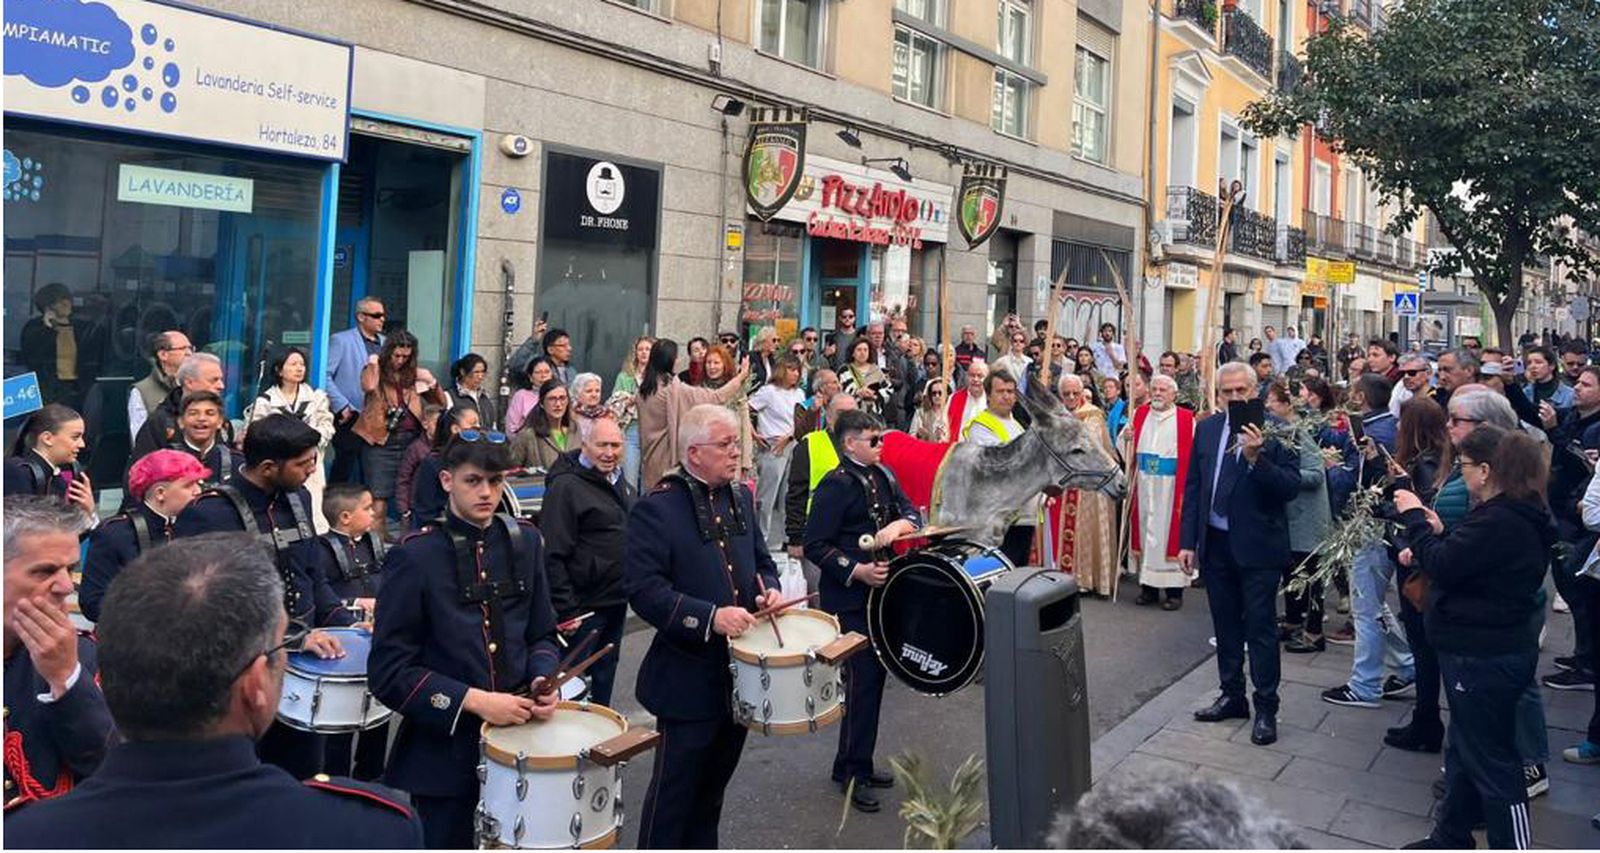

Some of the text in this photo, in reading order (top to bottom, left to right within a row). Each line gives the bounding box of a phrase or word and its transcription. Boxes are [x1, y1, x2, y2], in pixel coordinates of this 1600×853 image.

[267, 81, 337, 109] Self-service
[322, 133, 337, 151] 84
[128, 176, 245, 202] LAVANDERÍA
